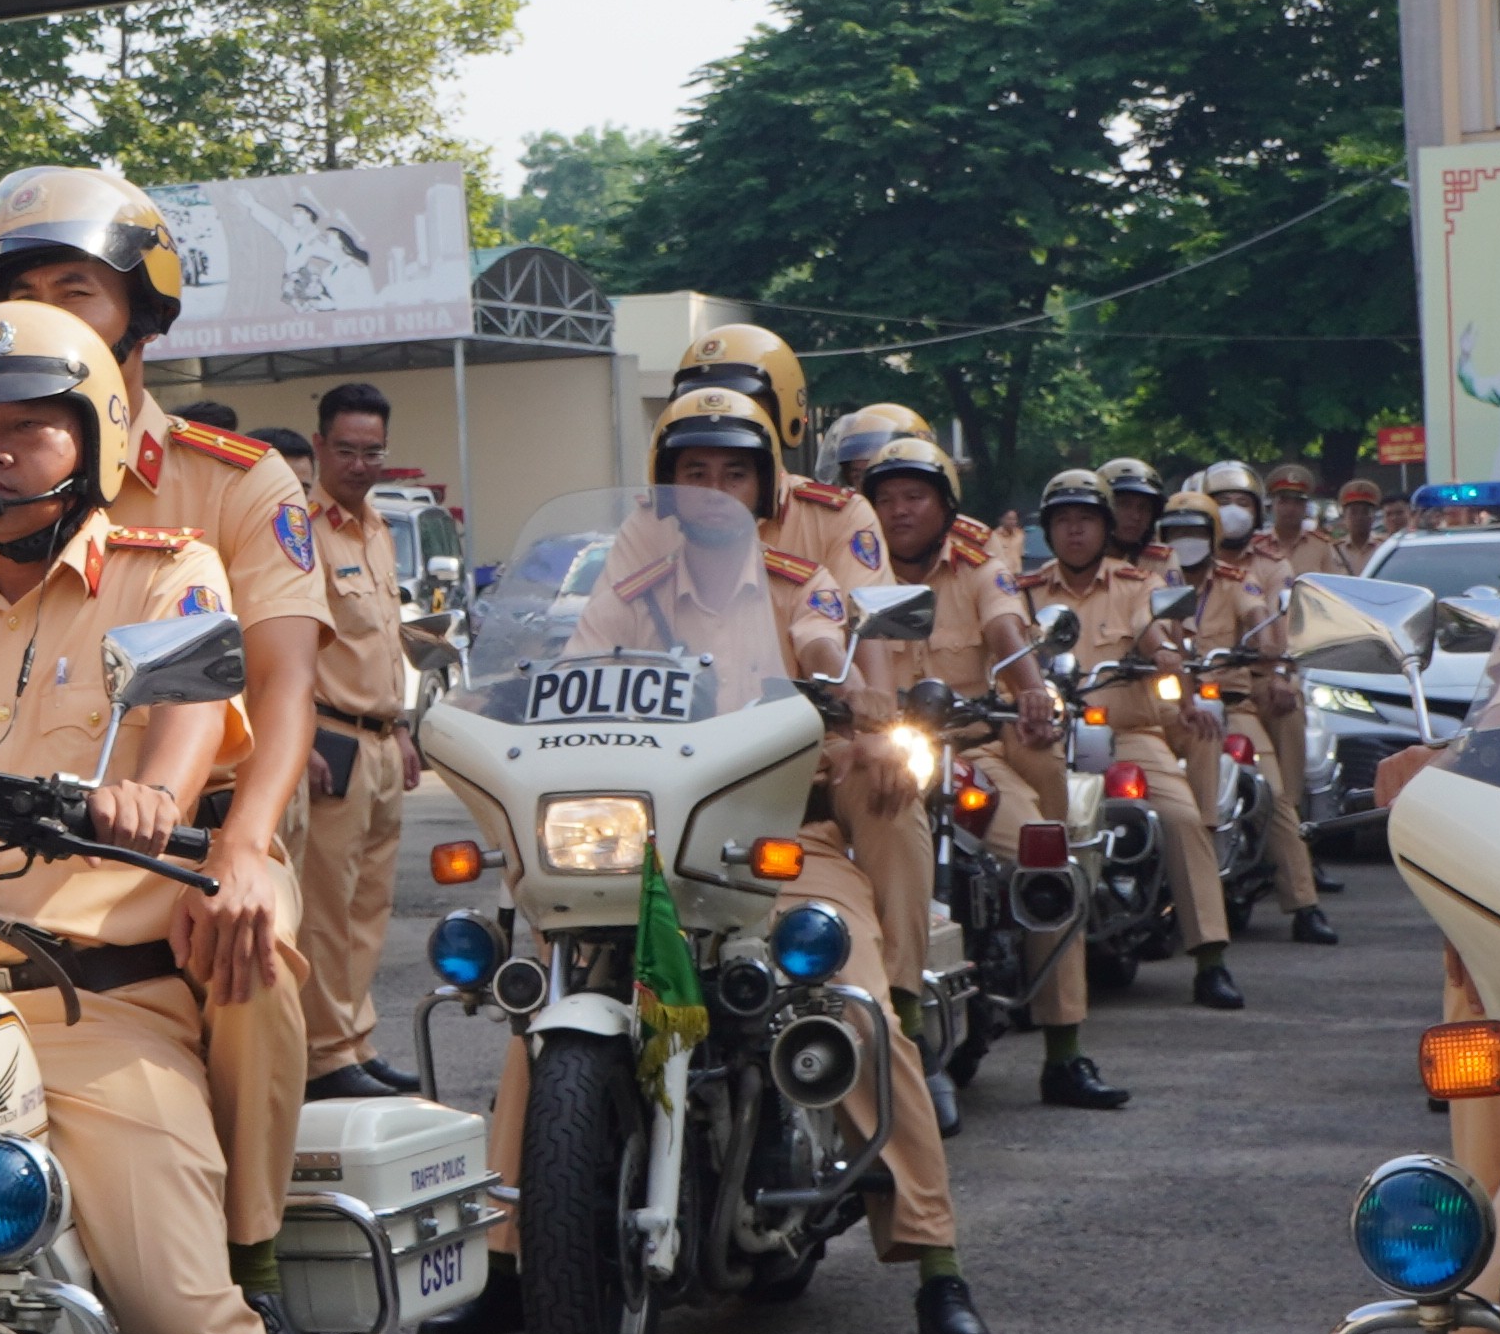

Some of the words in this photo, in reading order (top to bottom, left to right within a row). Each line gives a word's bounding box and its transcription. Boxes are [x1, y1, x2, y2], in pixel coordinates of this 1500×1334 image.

[170, 325, 223, 351] MỌI
[332, 312, 386, 340] MỌI
[530, 669, 689, 721] POLICE
[538, 732, 662, 750] HONDA
[411, 1163, 440, 1193] TRAFFIC
[420, 1238, 465, 1297] CSGT
